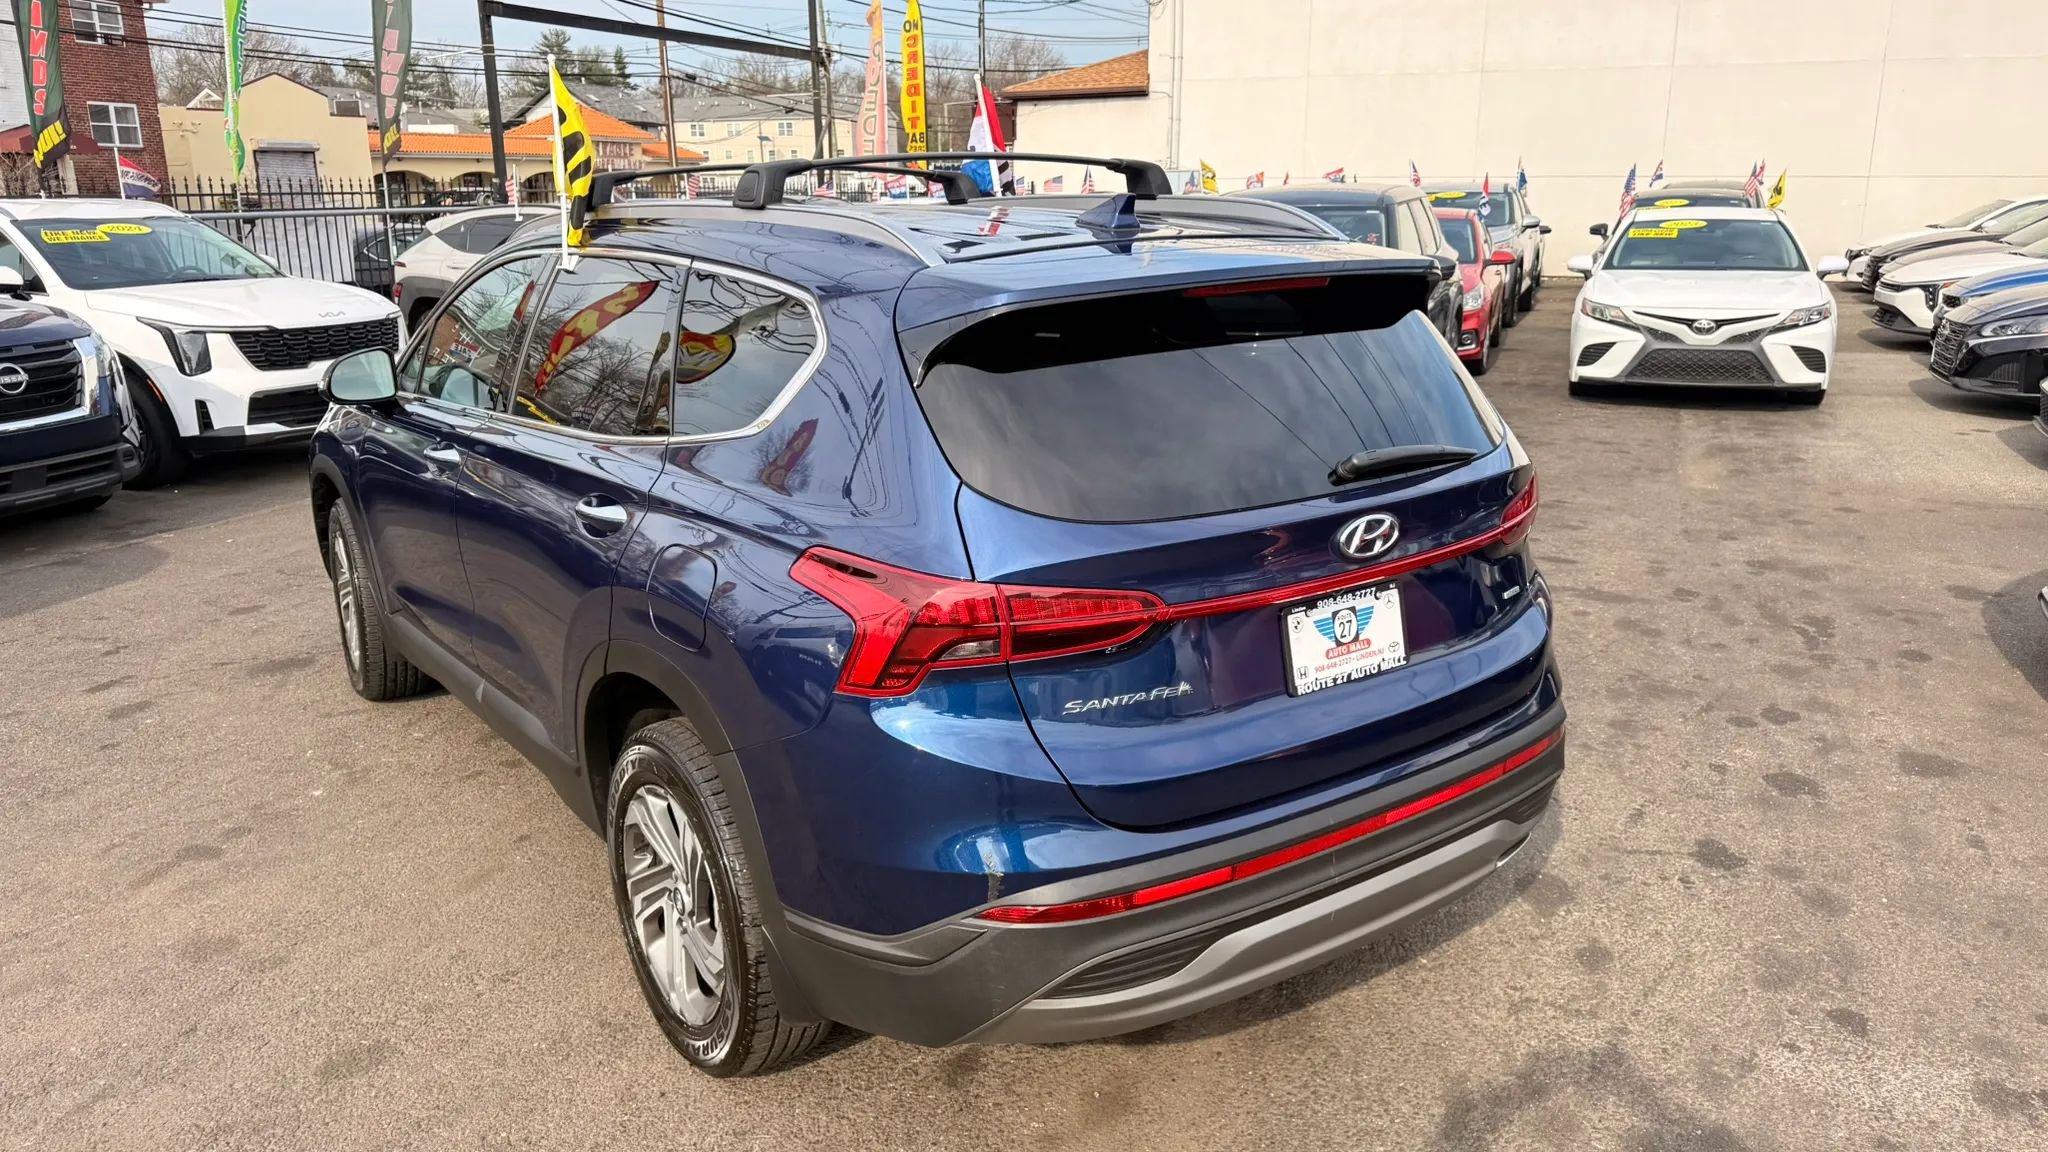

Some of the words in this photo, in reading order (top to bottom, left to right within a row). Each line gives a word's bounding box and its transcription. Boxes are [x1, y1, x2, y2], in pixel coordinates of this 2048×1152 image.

[1316, 587, 1376, 609] 908-648-2727
[1338, 619, 1353, 639] 27
[1327, 646, 1348, 659] AUTO
[1297, 677, 1335, 696] ROUTE
[1335, 672, 1349, 684] 27
[1350, 663, 1379, 680] AUTO
[1380, 655, 1407, 672] MALL
[1062, 692, 1147, 715] SANTA
